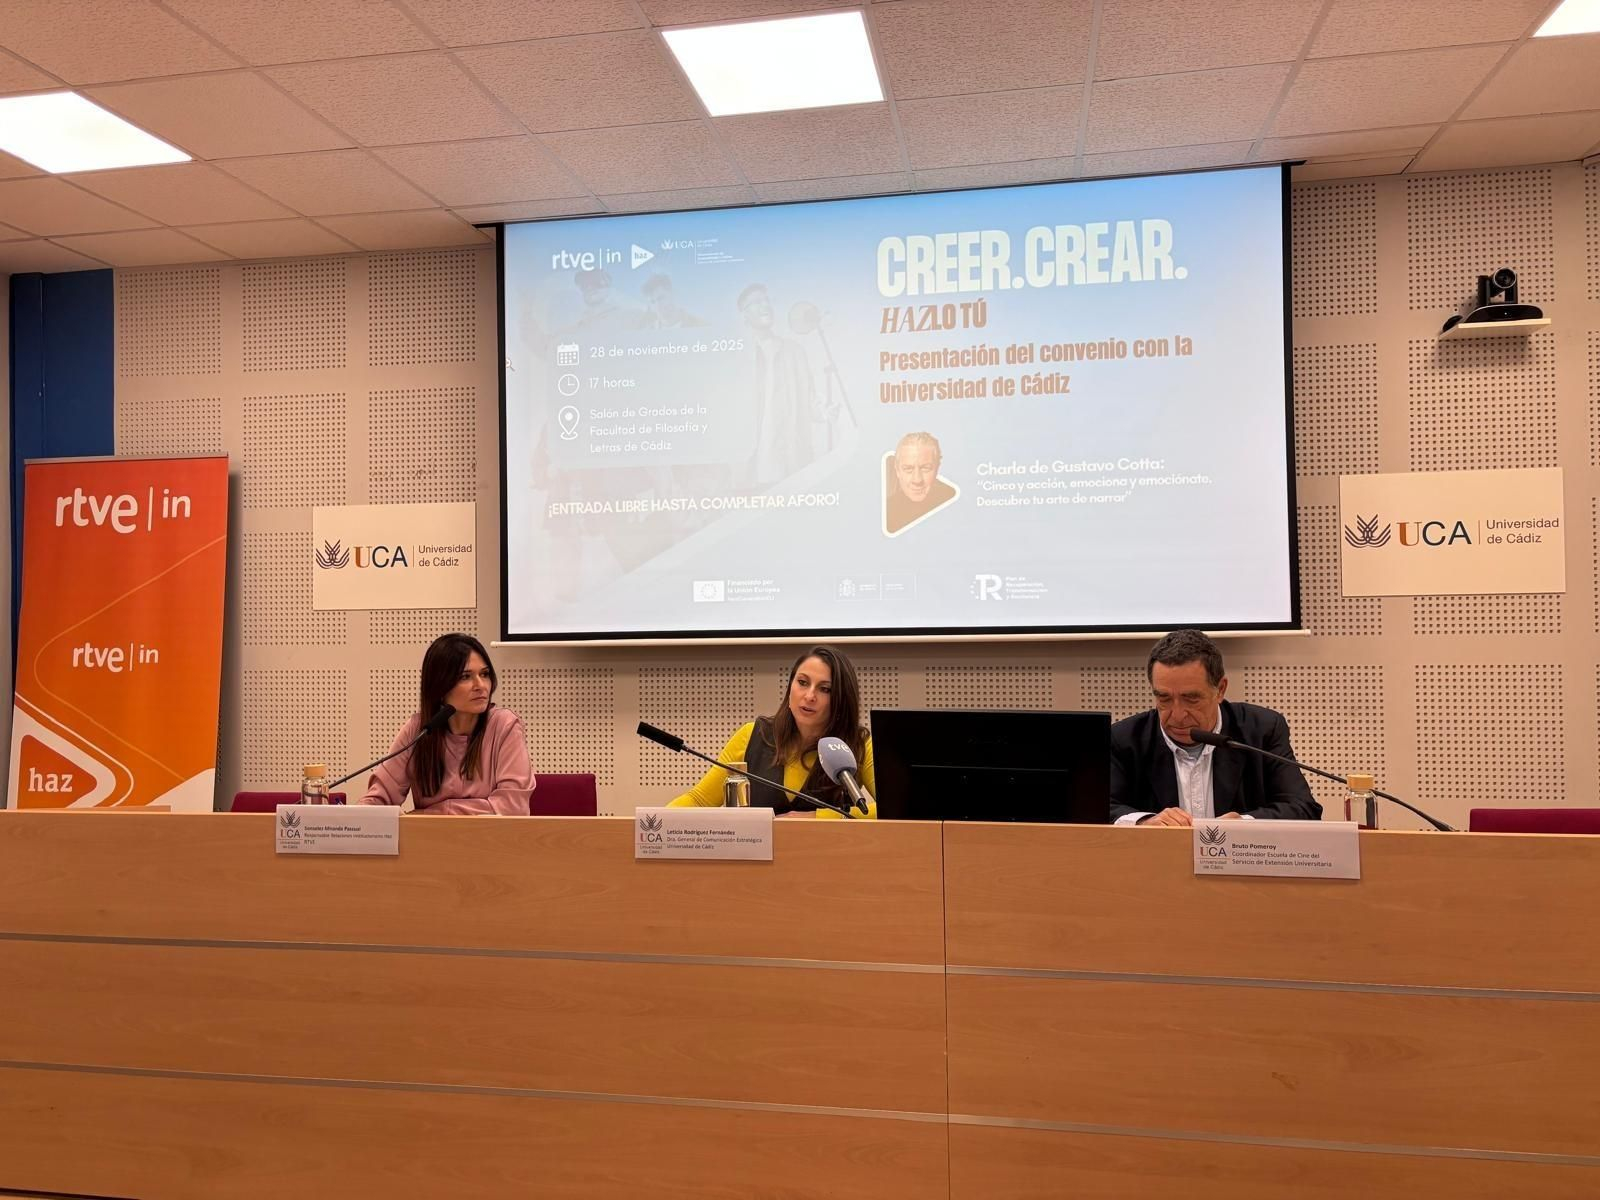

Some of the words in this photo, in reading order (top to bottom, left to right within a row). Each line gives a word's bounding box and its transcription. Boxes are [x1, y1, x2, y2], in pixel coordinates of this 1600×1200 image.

[552, 249, 594, 271] rtve
[606, 248, 622, 264] in
[876, 218, 1188, 298] CREER.CREAR.
[960, 297, 988, 329] TÚ
[590, 346, 604, 358] 28
[608, 345, 623, 357] de
[627, 341, 688, 357] noviembre
[691, 341, 708, 353] de
[711, 339, 744, 352] 2025
[879, 343, 1000, 372] Presentación
[1005, 341, 1034, 365] del
[1039, 337, 1128, 363] convenio
[1133, 337, 1169, 358] con
[1174, 335, 1193, 356] la
[589, 377, 600, 389] 17
[603, 376, 636, 389] horas
[879, 376, 987, 403] Universidad
[991, 375, 1016, 397] de
[1020, 371, 1070, 395] Cádiz
[589, 407, 619, 420] Salón
[622, 406, 636, 418] de
[638, 404, 677, 417] Grados
[680, 403, 694, 416] de
[697, 402, 707, 415] la
[589, 423, 636, 436] Facultad
[638, 422, 652, 434] de
[701, 422, 708, 435] y
[589, 442, 622, 453] Letras
[624, 440, 638, 452] de
[640, 438, 672, 451] Cádiz
[976, 461, 1026, 476] Charla
[1029, 460, 1049, 474] de
[1052, 459, 1115, 473] Gustavo
[1117, 457, 1166, 471] Cotta:
[1017, 481, 1025, 493] y
[1070, 476, 1128, 489] emociona
[1129, 477, 1137, 489] y
[615, 499, 649, 513] LIBRE
[651, 498, 698, 512] HASTA
[700, 495, 785, 511] COMPLETAR
[787, 492, 840, 507] AFORO!
[976, 495, 1030, 507] Descubre
[1032, 495, 1044, 505] tu
[1045, 495, 1071, 505] arte
[1072, 492, 1088, 504] de
[55, 487, 139, 534] rtve
[162, 488, 191, 519] in
[1486, 517, 1560, 530] Universidad
[1397, 520, 1472, 547] UCA
[1487, 533, 1502, 544] de
[1506, 532, 1542, 544] Cádiz
[353, 545, 408, 569] UCA
[418, 544, 473, 554] Universidad
[418, 557, 430, 567] de
[432, 556, 459, 567] Cádiz
[72, 642, 125, 673] rtve
[139, 644, 159, 664] in
[28, 767, 73, 793] haz
[640, 832, 663, 843] UCA
[1200, 847, 1227, 857] UCA
[1249, 843, 1277, 851] Pomeroy
[1294, 860, 1332, 868] Universitaria
